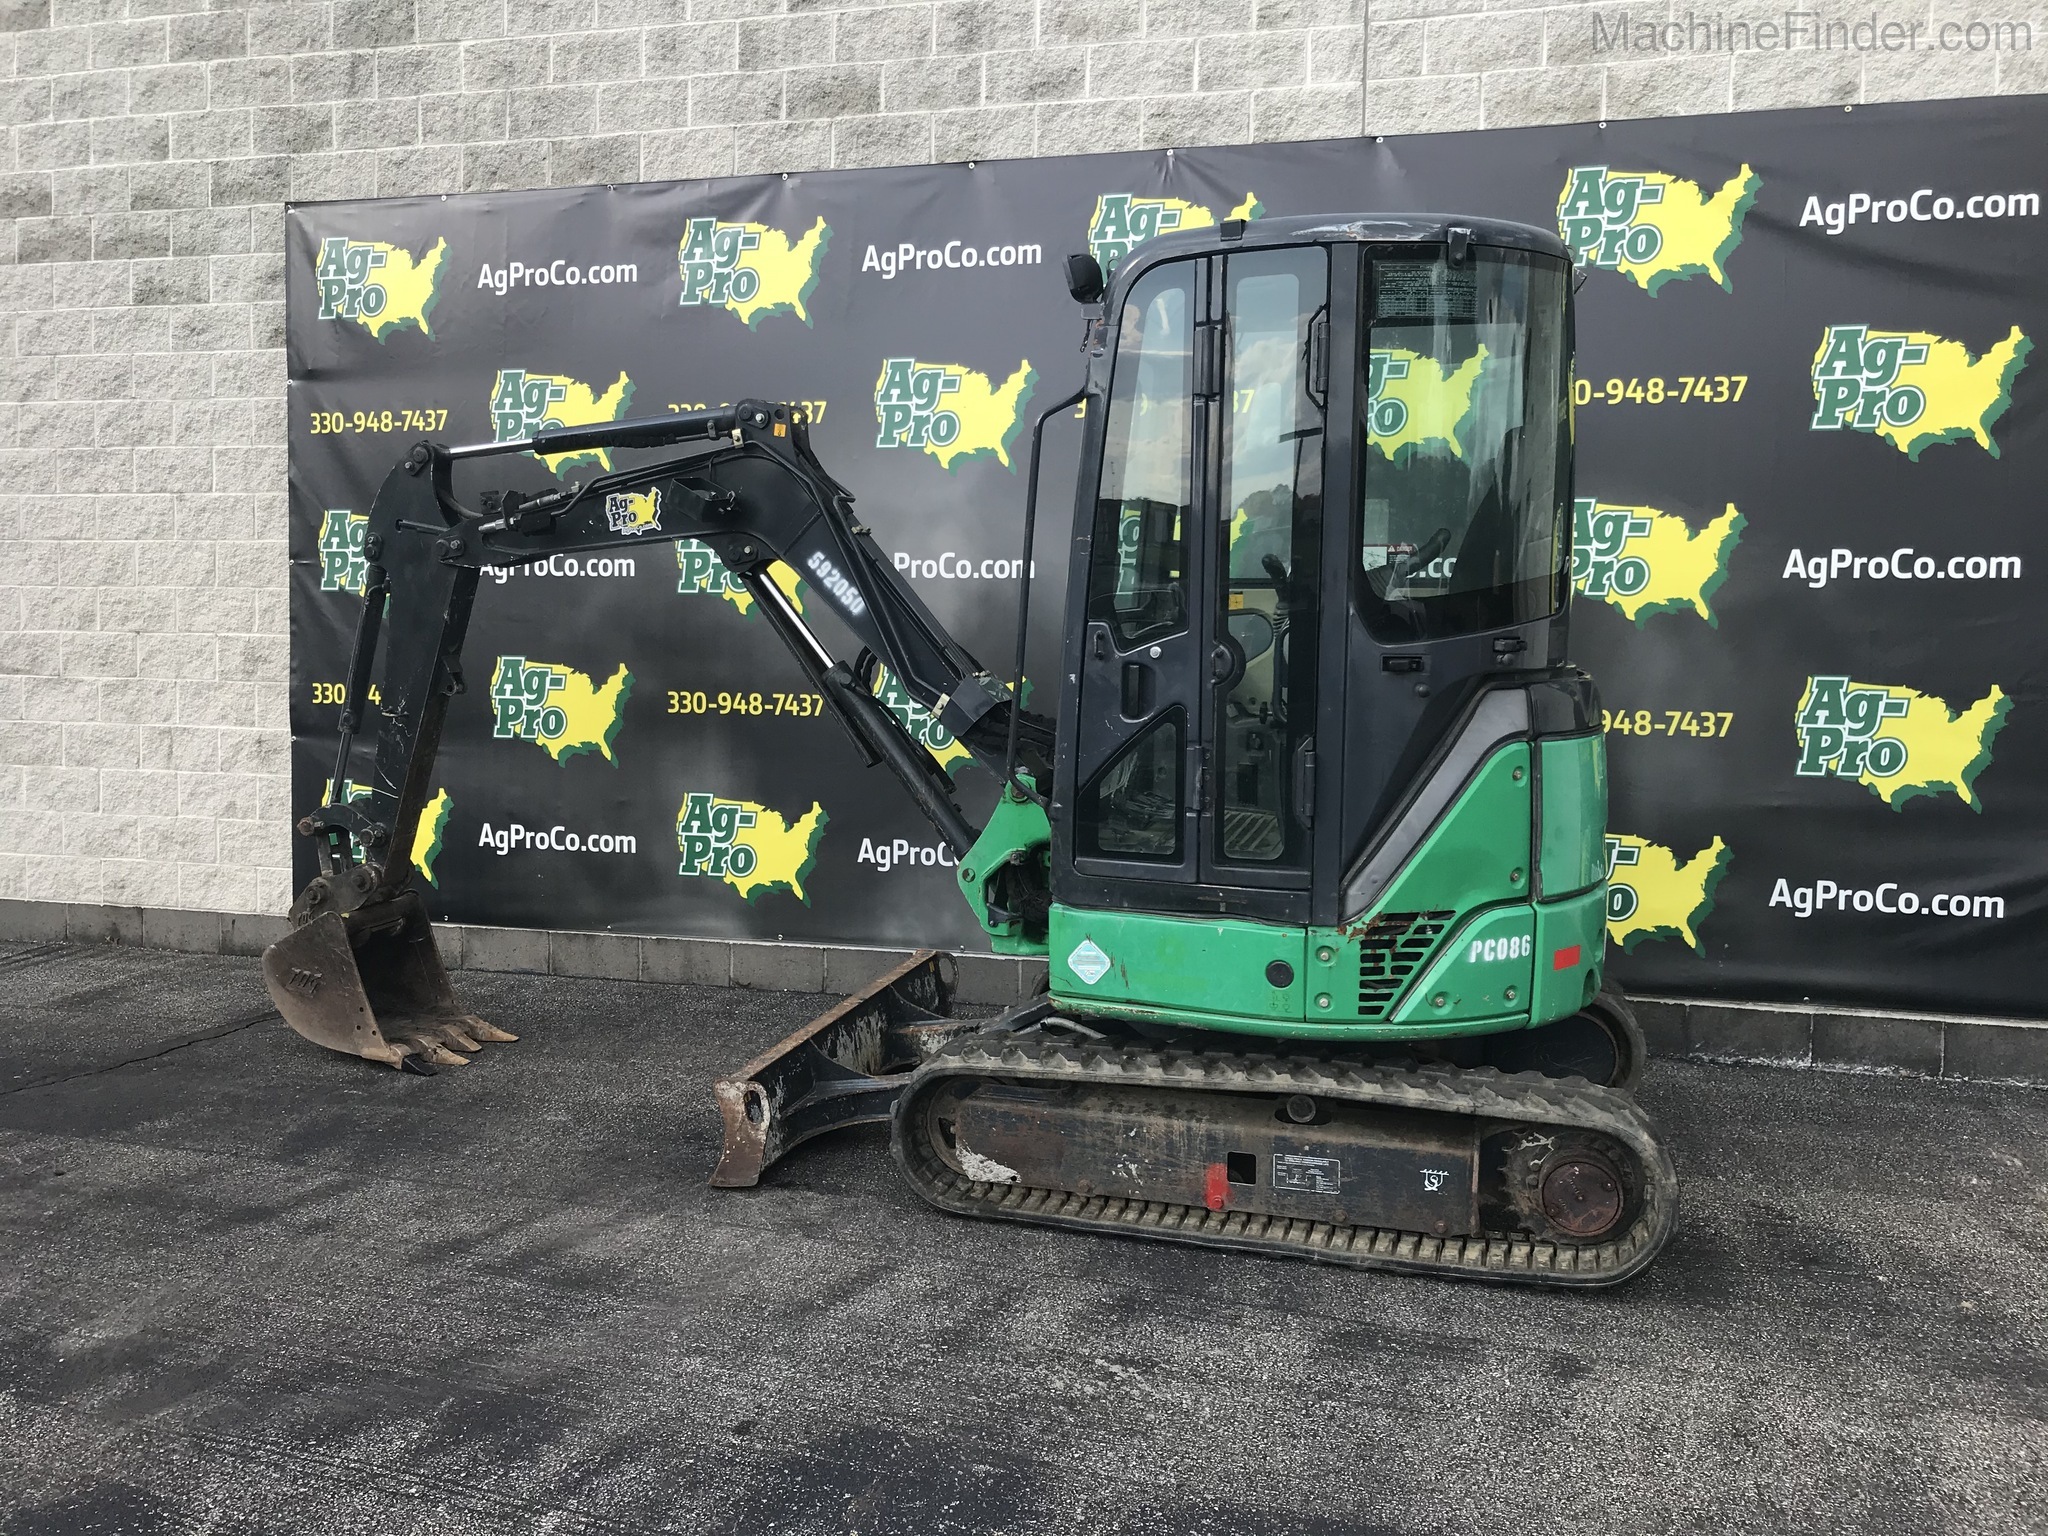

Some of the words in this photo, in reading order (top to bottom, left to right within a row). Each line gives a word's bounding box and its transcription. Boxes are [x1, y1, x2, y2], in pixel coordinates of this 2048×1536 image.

[1560, 167, 1663, 226] Ag-
[1799, 189, 2040, 235] AgProCo.com
[319, 237, 385, 280] Ag-
[682, 217, 760, 264] Ag-
[861, 240, 1042, 280] AgProCo.com
[1563, 218, 1661, 266] Pro
[318, 277, 387, 320] Pro
[477, 259, 638, 296] AgProCo.com
[680, 259, 760, 306] Pro
[1815, 325, 1929, 378] Ag-
[492, 370, 566, 421] Ag-
[877, 358, 961, 405] Ag-
[310, 408, 448, 435] 330-948-7437
[1811, 377, 1925, 430] Pro
[876, 402, 961, 449] Pro
[610, 496, 634, 514] Ag-
[610, 512, 637, 528] Pro
[320, 550, 371, 591] Pr
[807, 551, 866, 616] 592050
[1782, 548, 2022, 589] AgProCo.com
[492, 657, 566, 700] Ag-
[492, 699, 568, 739] Pro
[667, 691, 824, 717] 330-948-7437
[1798, 677, 1909, 738] Ag-
[1796, 726, 1907, 776] Pro
[680, 793, 757, 836] Ag-
[478, 822, 637, 856] AgProCo.com
[679, 833, 757, 877] Pro
[857, 837, 960, 872] AgProC
[1768, 878, 2005, 919] AgProCo.com
